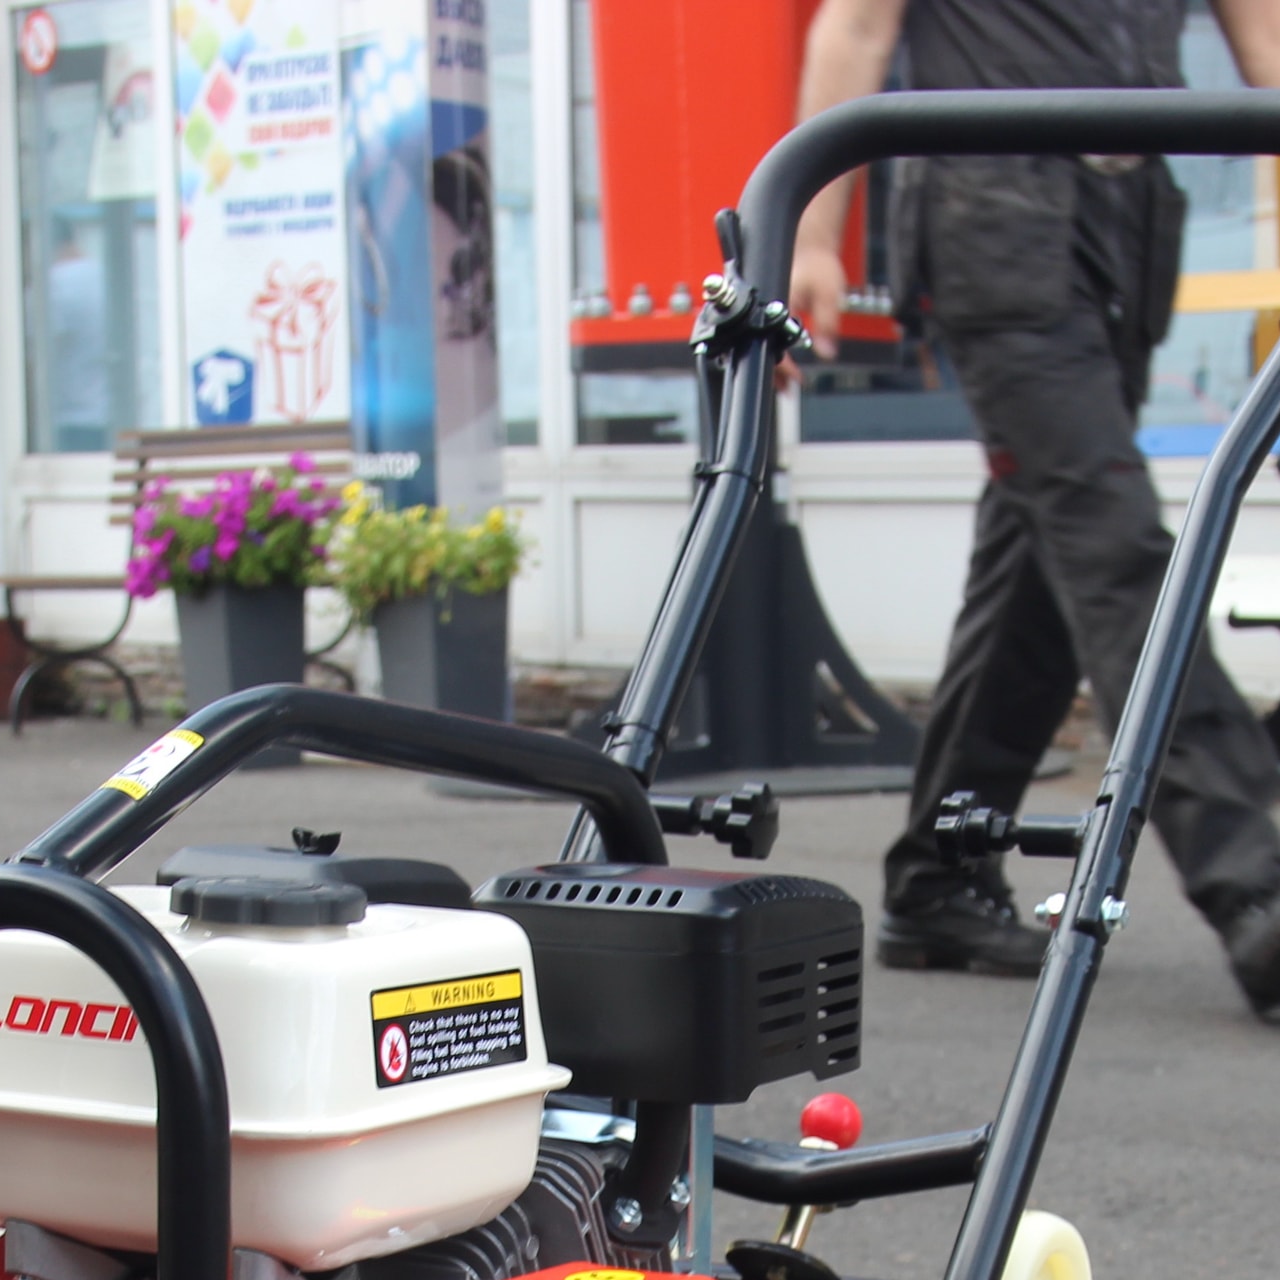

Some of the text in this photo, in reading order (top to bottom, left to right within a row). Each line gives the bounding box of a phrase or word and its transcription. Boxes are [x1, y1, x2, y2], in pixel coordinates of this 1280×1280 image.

[431, 981, 495, 1006] WARNING
[409, 1007, 520, 1034] Check that there is no any
[410, 1034, 426, 1048] fuel
[458, 1028, 468, 1040] or
[470, 1024, 486, 1038] fuel
[435, 1044, 449, 1057] fuel
[450, 1040, 474, 1055] before
[509, 1033, 521, 1047] the
[412, 1061, 439, 1078] engine
[440, 1058, 449, 1071] is
